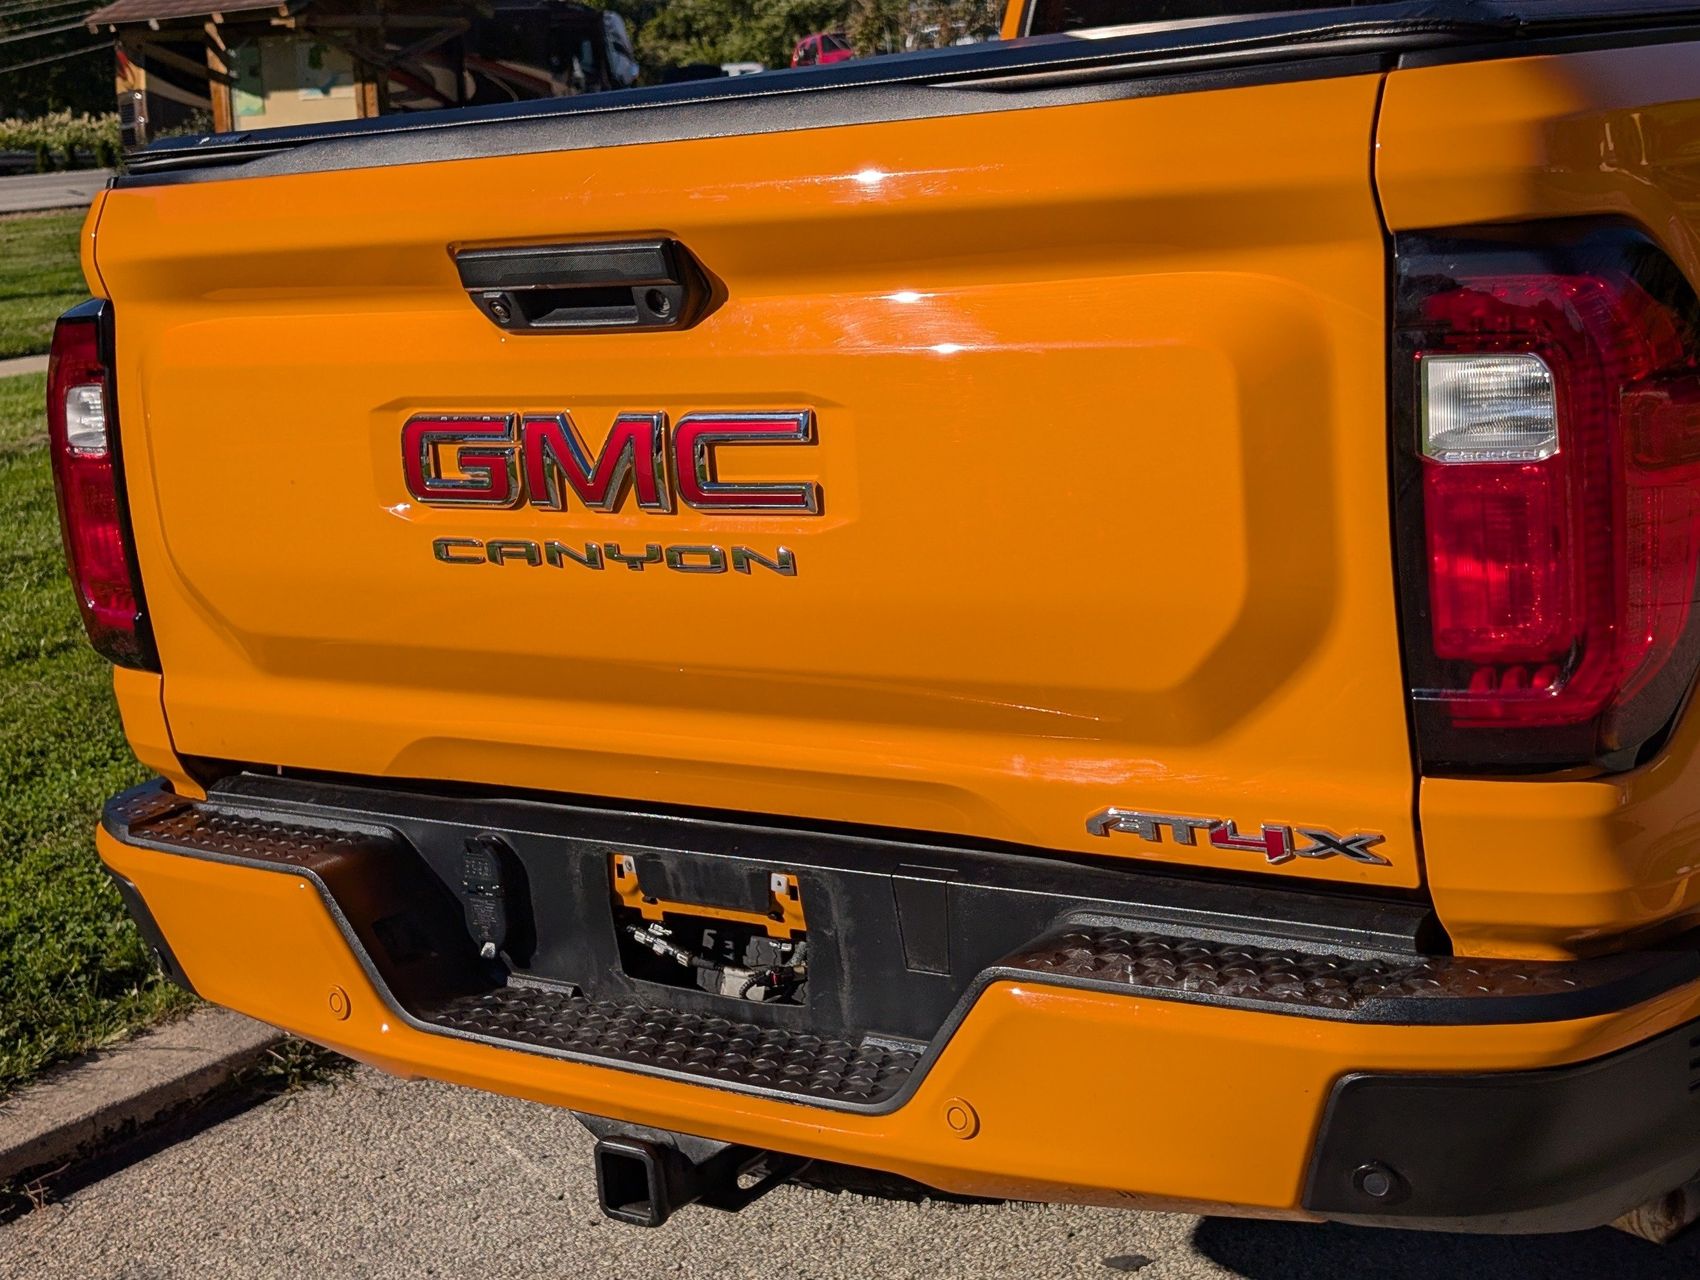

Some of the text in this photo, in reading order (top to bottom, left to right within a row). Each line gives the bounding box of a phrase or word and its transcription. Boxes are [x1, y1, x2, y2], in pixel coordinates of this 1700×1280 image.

[402, 409, 823, 515] GMC
[432, 537, 797, 576] CANYON
[1086, 806, 1391, 865] AT4X
